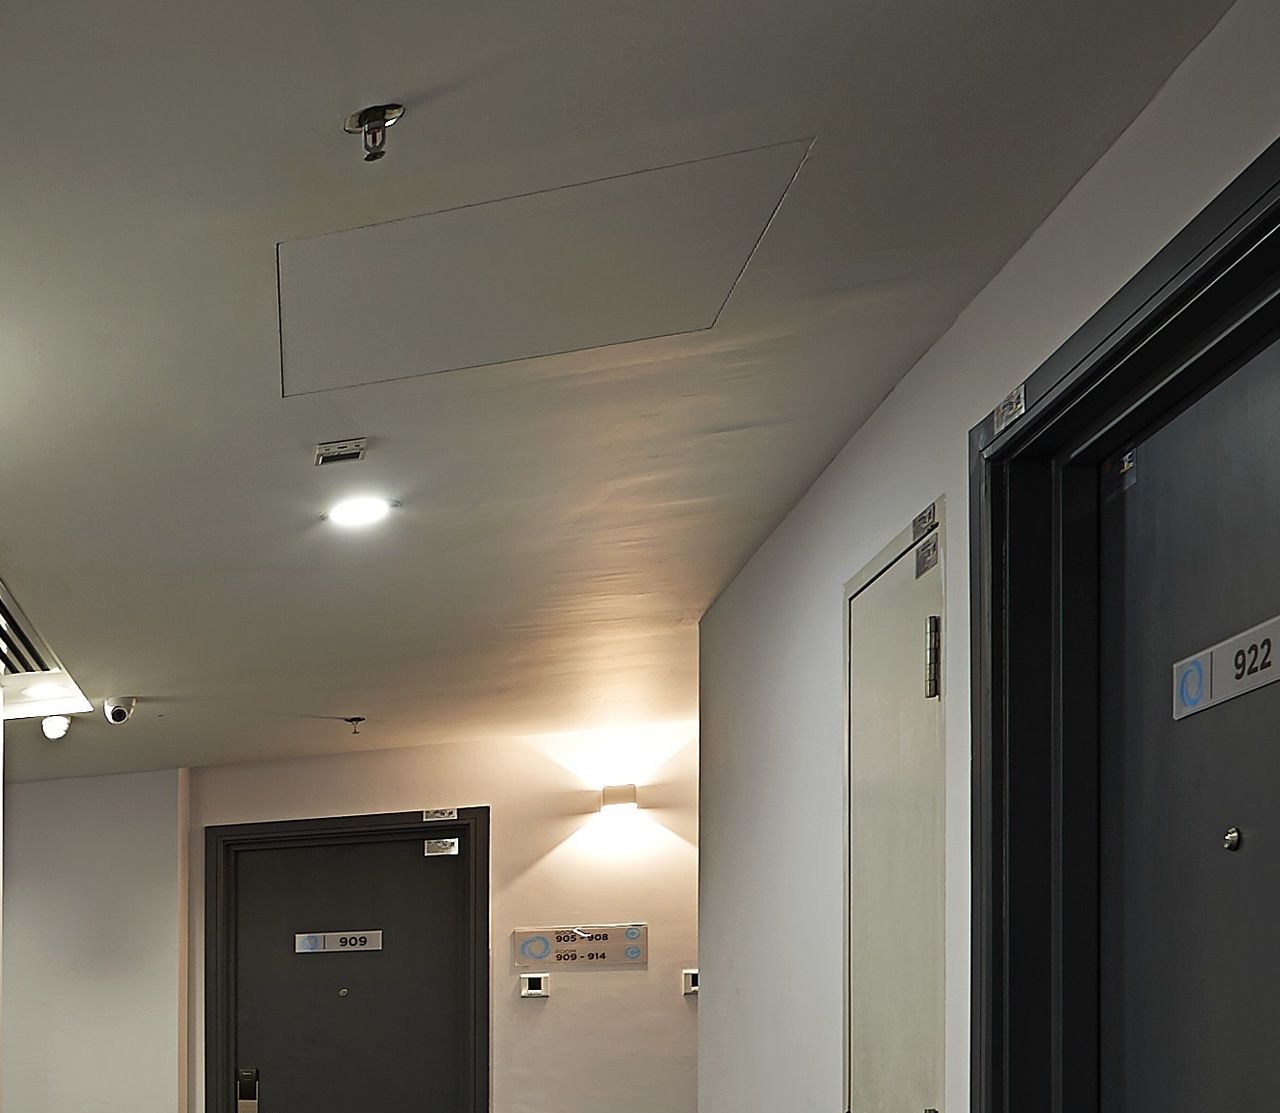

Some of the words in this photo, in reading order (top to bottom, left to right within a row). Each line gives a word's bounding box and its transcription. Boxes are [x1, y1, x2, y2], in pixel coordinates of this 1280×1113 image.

[1233, 638, 1272, 681] 922
[339, 936, 368, 947] 909
[555, 934, 577, 943] 905
[555, 953, 578, 961] 909
[587, 952, 607, 960] 914
